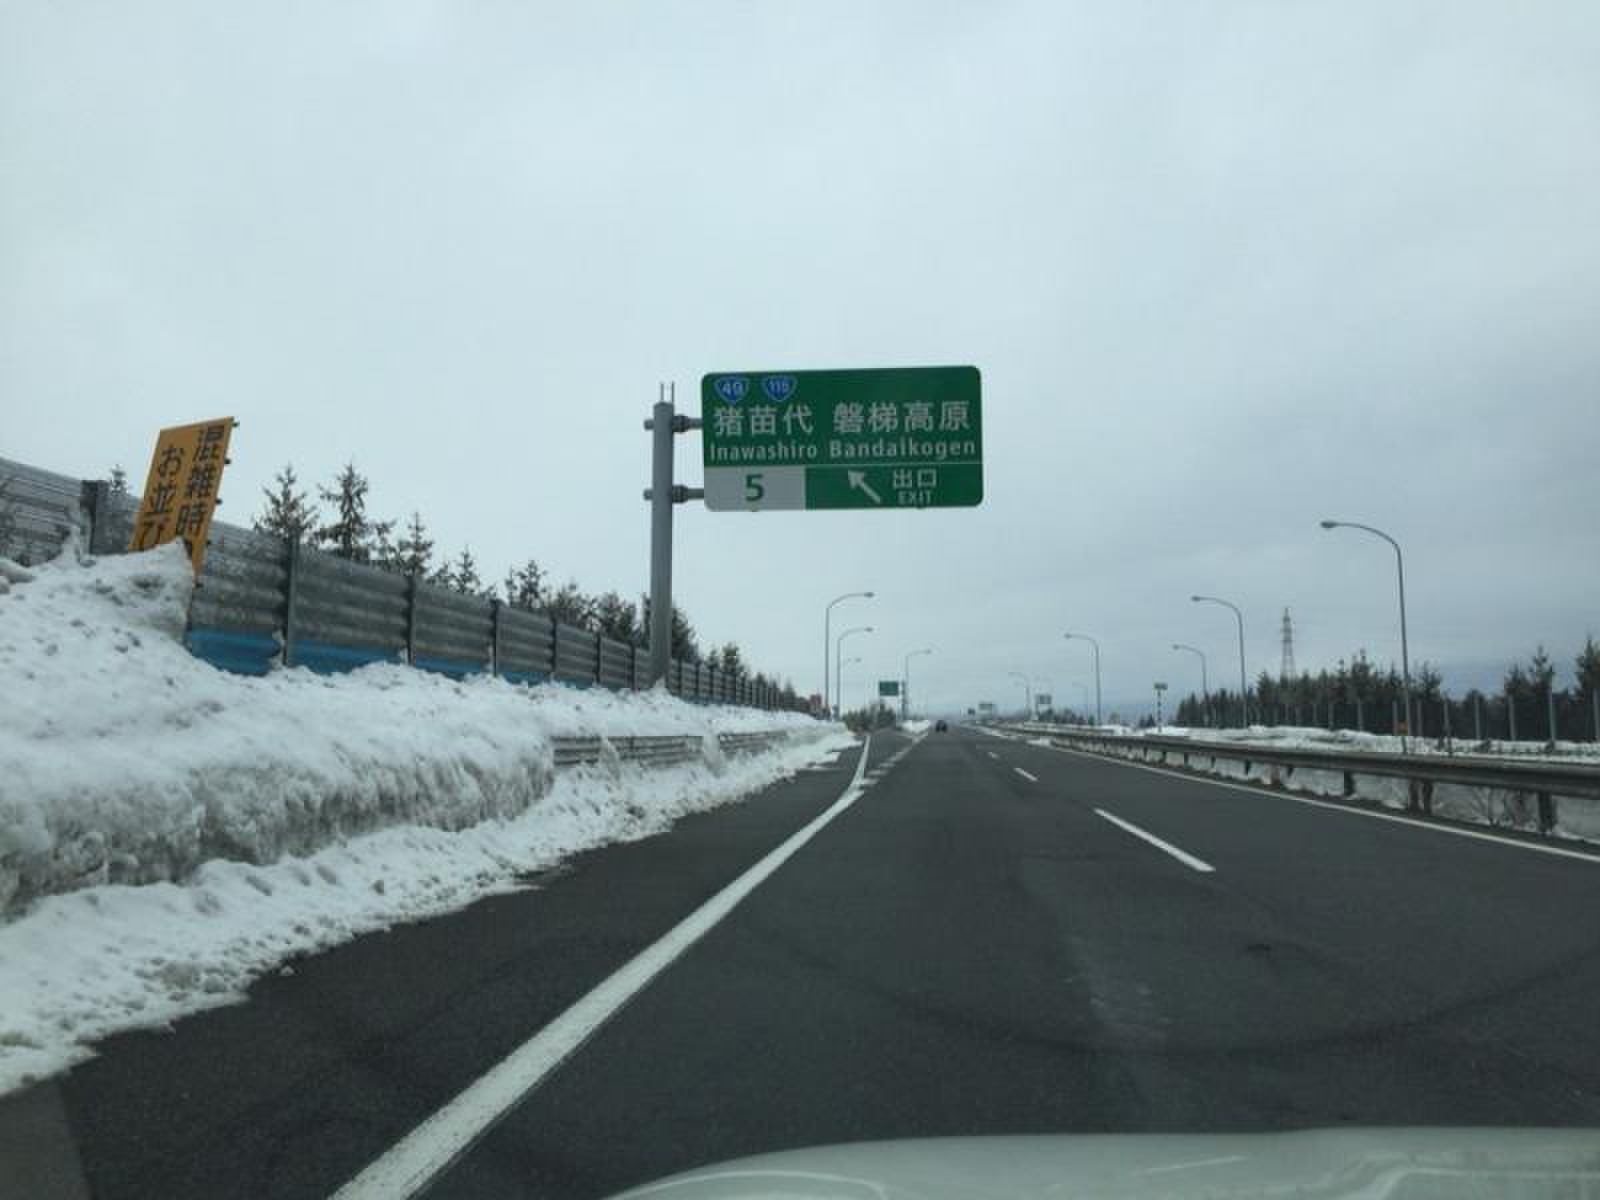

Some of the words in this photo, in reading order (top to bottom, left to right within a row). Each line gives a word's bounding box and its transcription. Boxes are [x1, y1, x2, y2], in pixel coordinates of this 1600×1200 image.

[713, 403, 814, 436] 猪苗代
[832, 400, 970, 433] 磐梯高原
[710, 441, 817, 460] Inawashiro
[830, 438, 976, 461] Bandaikogen
[744, 474, 765, 502] 5
[893, 469, 937, 489] 出口
[898, 490, 933, 504] EXIT
